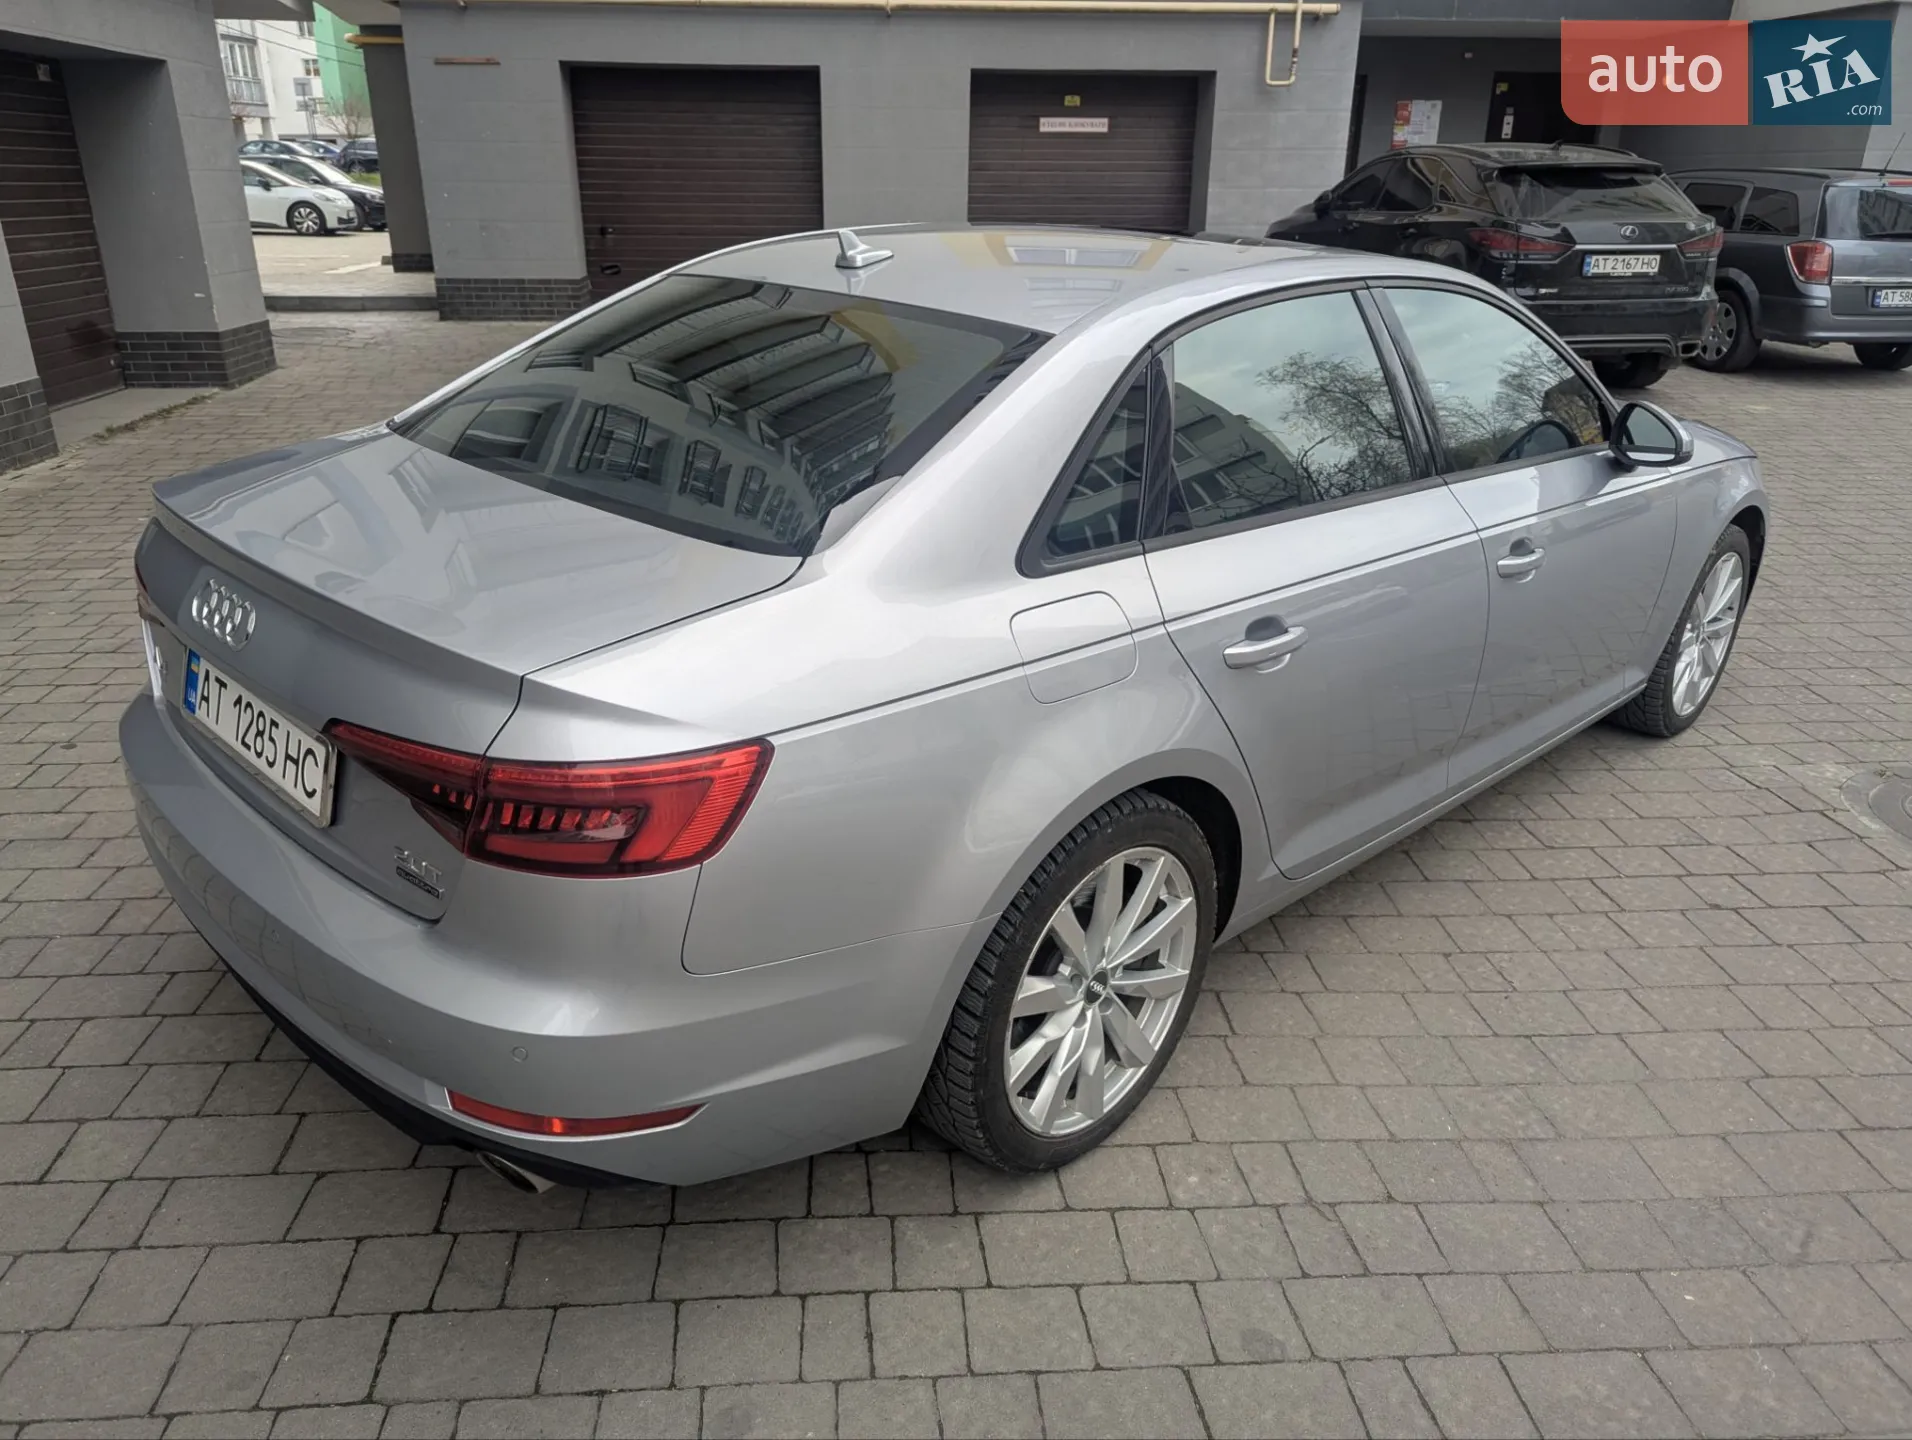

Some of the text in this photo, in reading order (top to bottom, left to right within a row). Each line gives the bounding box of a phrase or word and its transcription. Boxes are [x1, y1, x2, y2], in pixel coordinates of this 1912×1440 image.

[1591, 257, 1658, 271] AT 2167 HO
[1881, 291, 1898, 303] AT
[199, 667, 320, 799] AT 1285 HC
